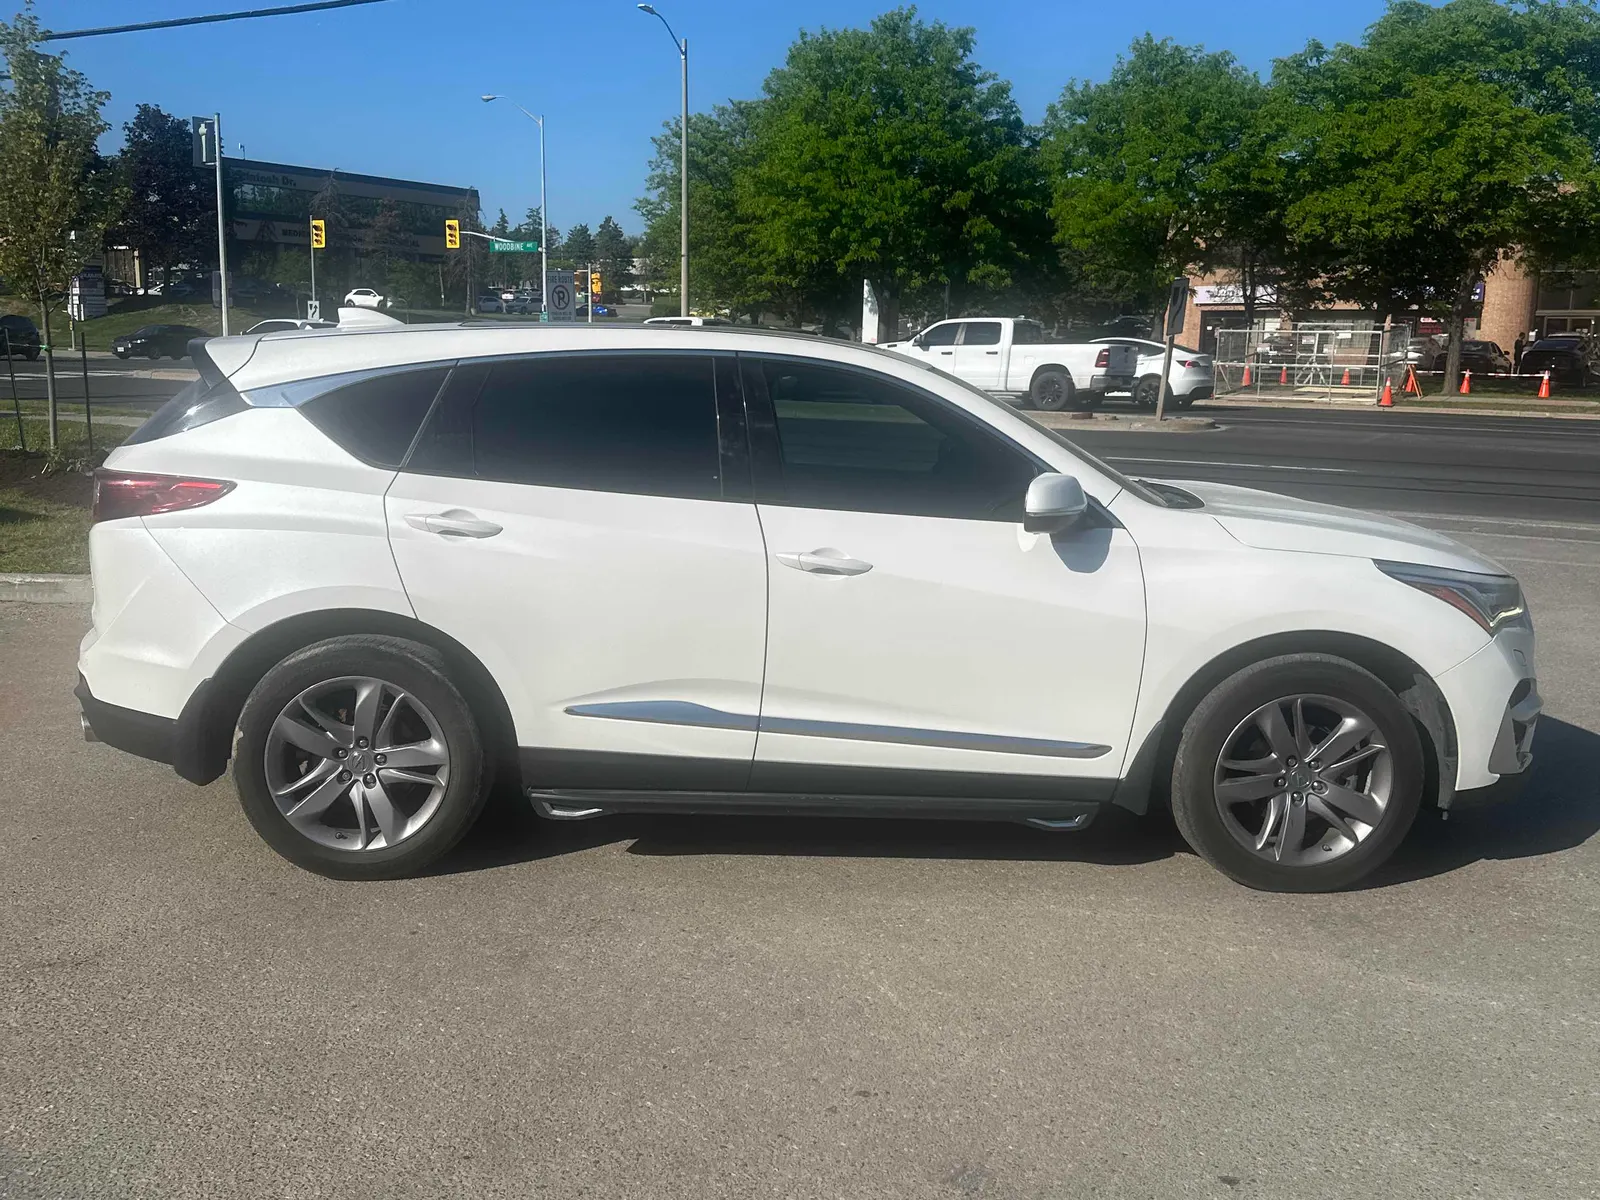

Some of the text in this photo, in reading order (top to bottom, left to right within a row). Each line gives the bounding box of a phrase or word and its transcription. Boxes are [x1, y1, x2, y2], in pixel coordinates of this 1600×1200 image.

[494, 242, 524, 251] WOODBINE
[547, 275, 573, 284] FIRE ROUTE
